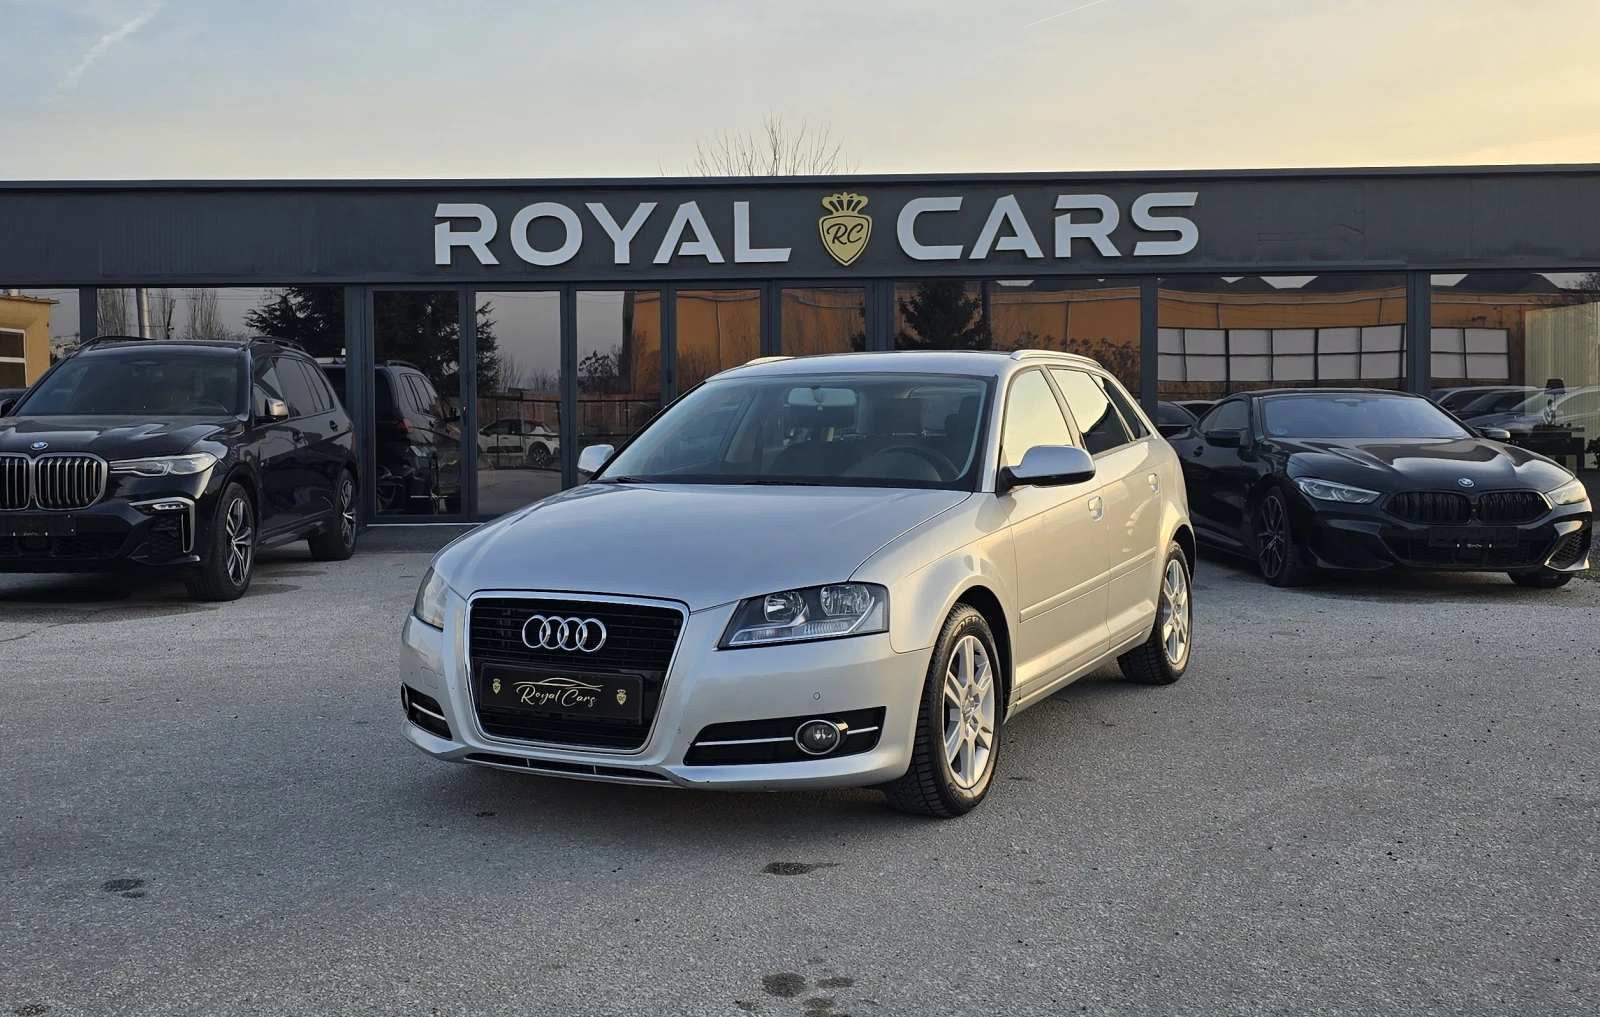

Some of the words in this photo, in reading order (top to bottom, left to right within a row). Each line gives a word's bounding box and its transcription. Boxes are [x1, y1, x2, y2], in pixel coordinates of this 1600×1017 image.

[434, 200, 792, 266] ROYAL
[896, 192, 1199, 260] CARS
[826, 223, 864, 245] RC
[516, 685, 562, 705] Royal
[561, 689, 597, 707] Cars
